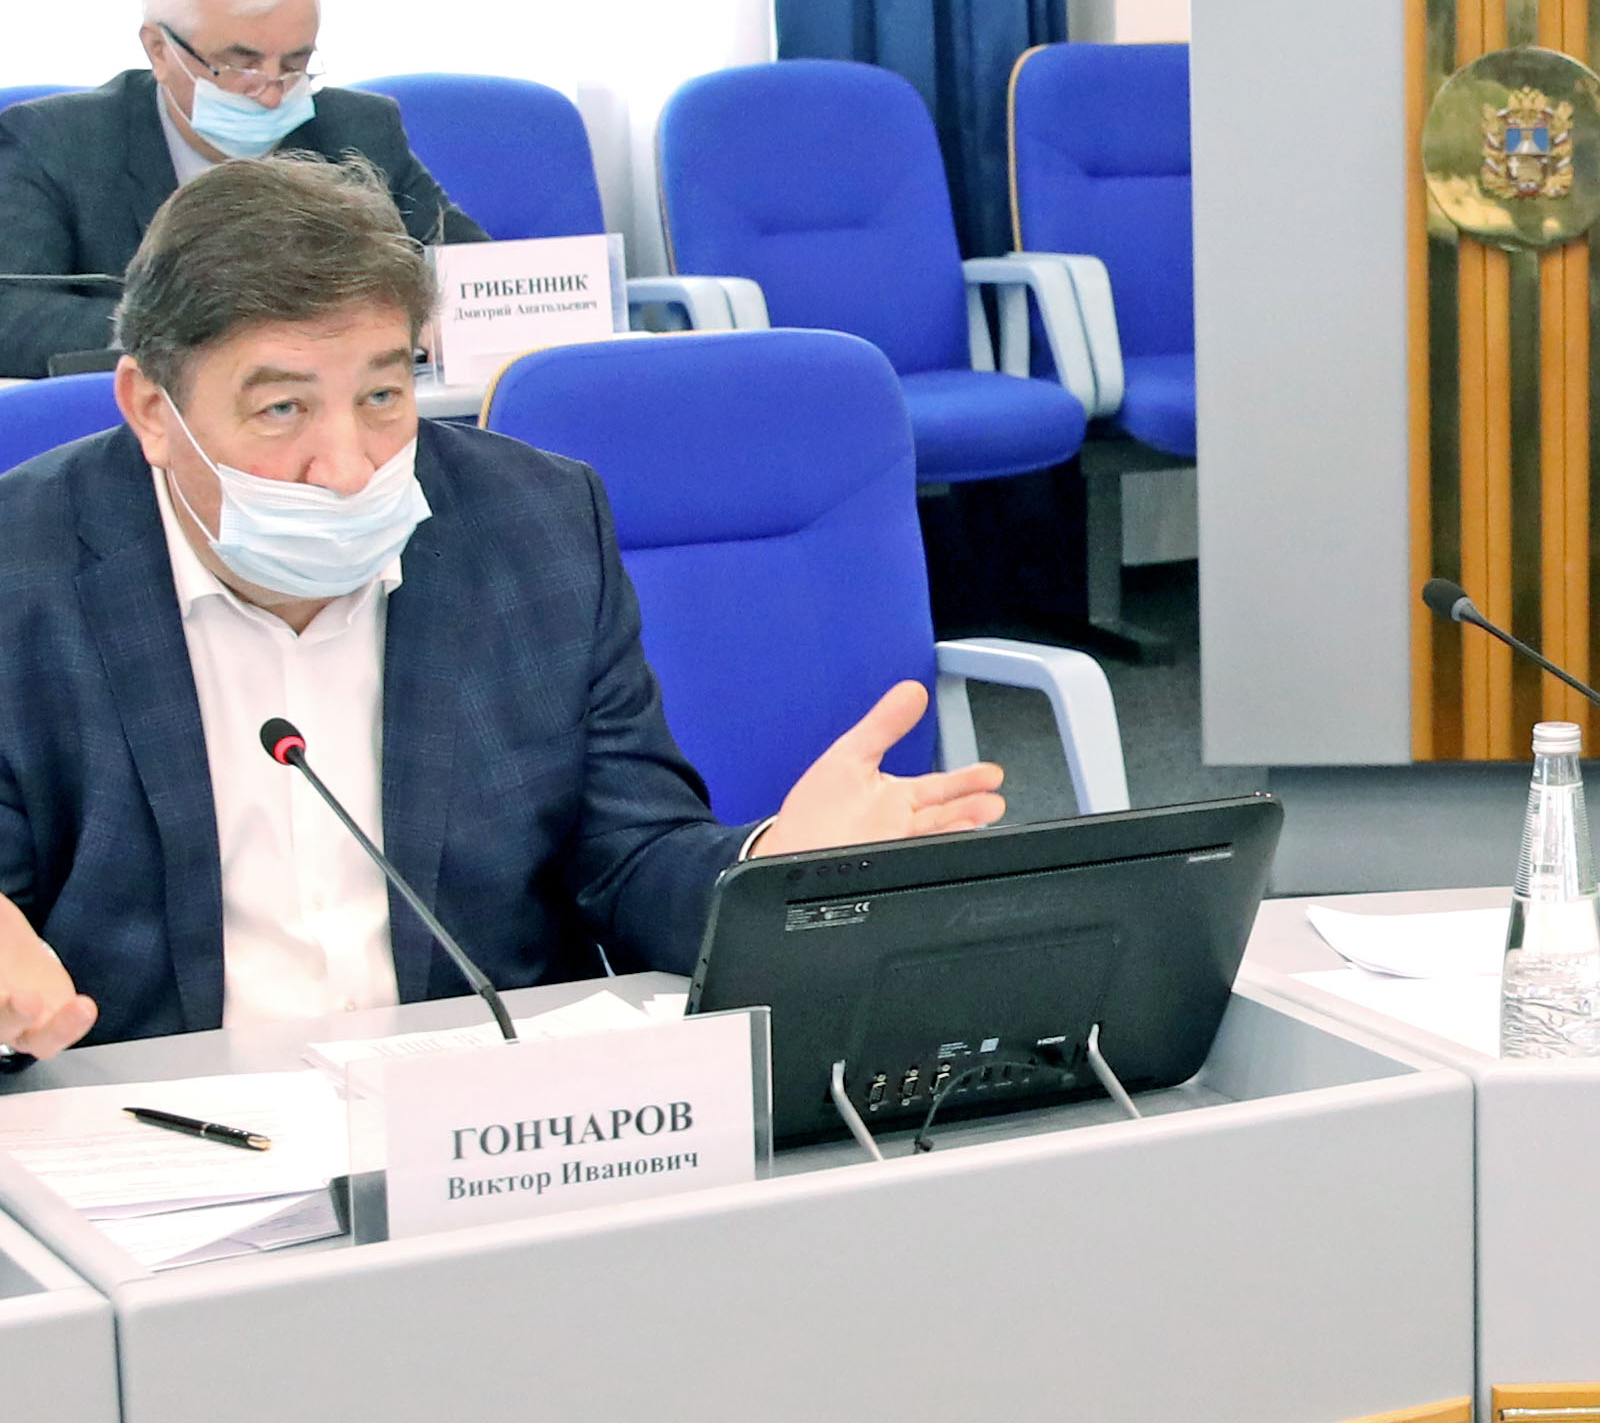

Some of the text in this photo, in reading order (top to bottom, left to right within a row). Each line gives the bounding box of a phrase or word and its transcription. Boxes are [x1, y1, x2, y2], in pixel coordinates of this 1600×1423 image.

[460, 274, 589, 299] ГРИБЕННИК
[454, 300, 598, 321] Дмитрий Анатольевич
[450, 1101, 694, 1160] ГОНЧАРОВ
[447, 1151, 699, 1200] Виктор Иванович
